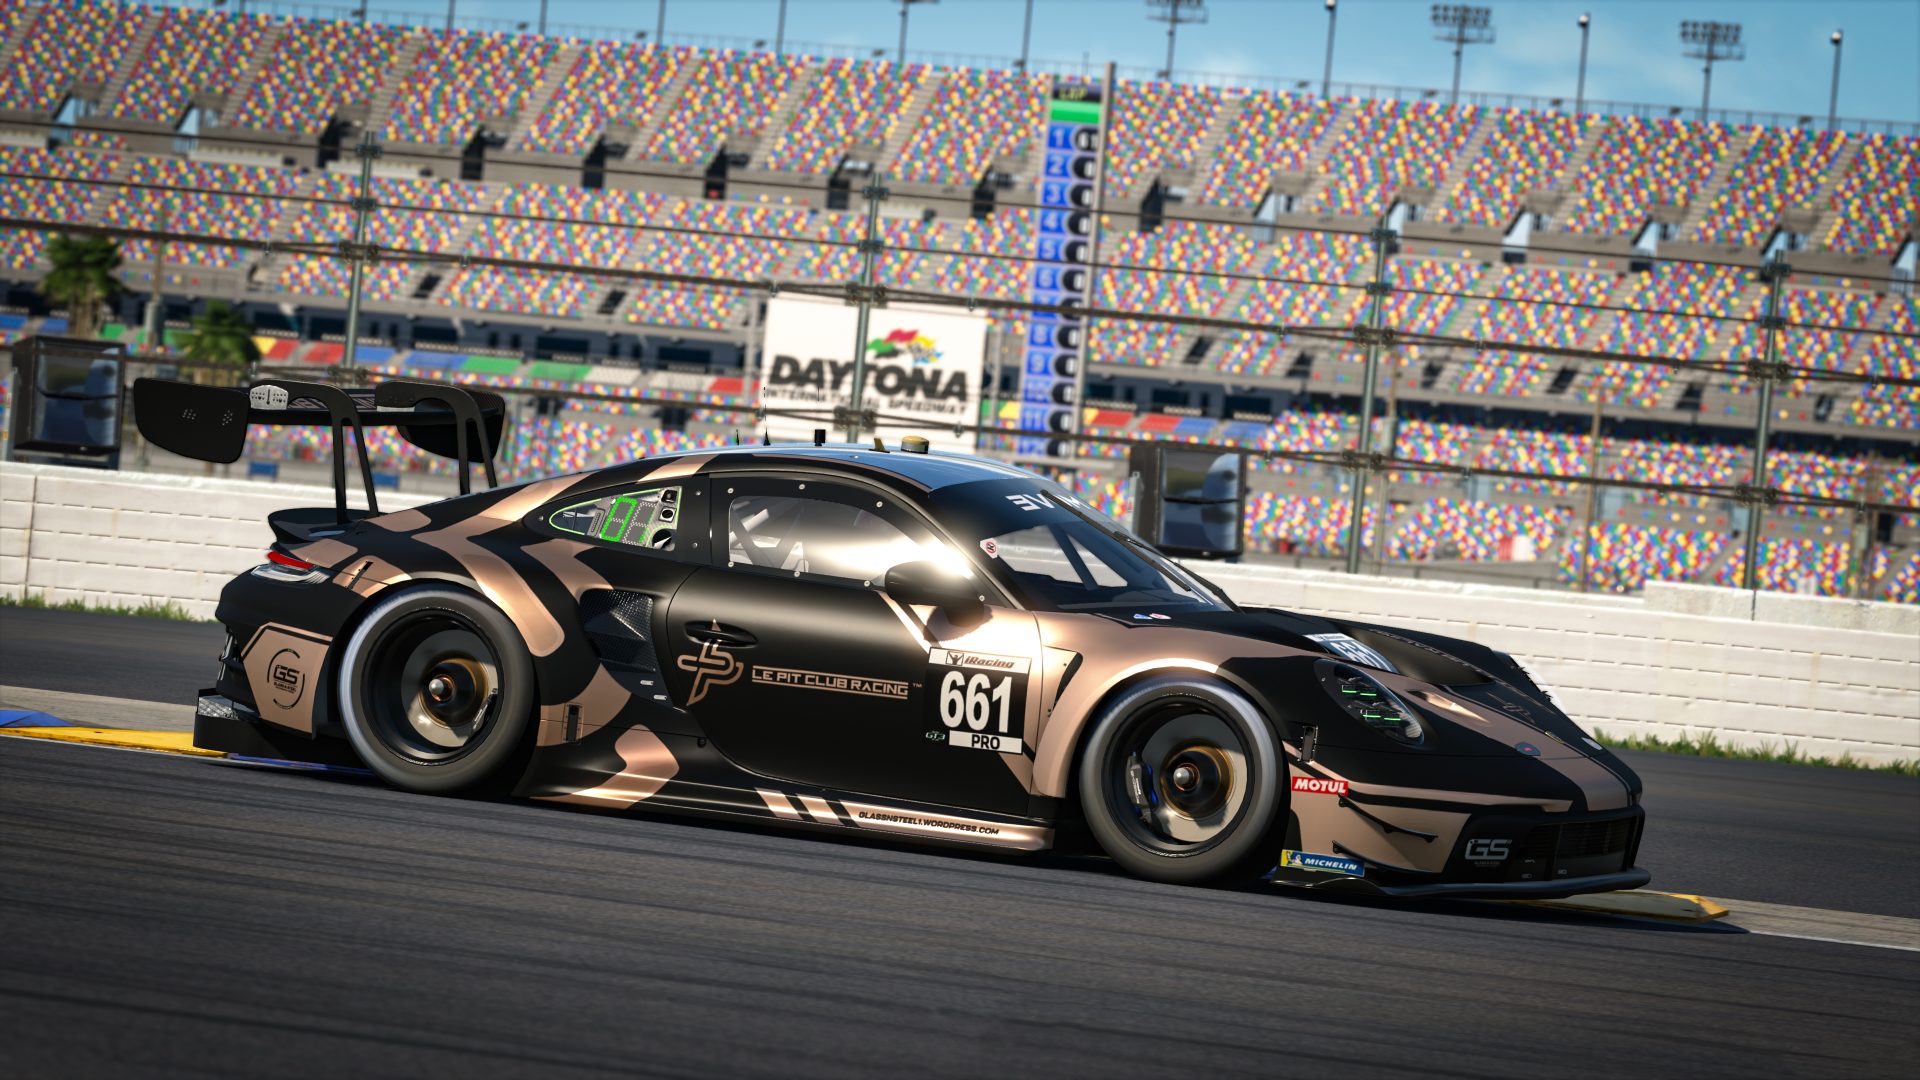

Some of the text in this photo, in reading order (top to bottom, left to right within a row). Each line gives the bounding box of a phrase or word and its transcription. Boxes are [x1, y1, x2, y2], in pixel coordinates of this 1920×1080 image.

[1052, 128, 1065, 148] 1
[1048, 157, 1063, 178] 2
[1043, 213, 1058, 233] 4
[769, 355, 968, 401] DAYTONA
[964, 655, 1015, 669] iRacing
[752, 669, 773, 681] LE
[776, 671, 801, 685] PIT
[804, 674, 848, 689] CLUB
[850, 679, 909, 696] RACING
[939, 669, 1012, 733] 661
[971, 733, 1000, 750] PRO
[1293, 778, 1347, 794] MOTUL
[1304, 857, 1358, 871] MICHELIN
